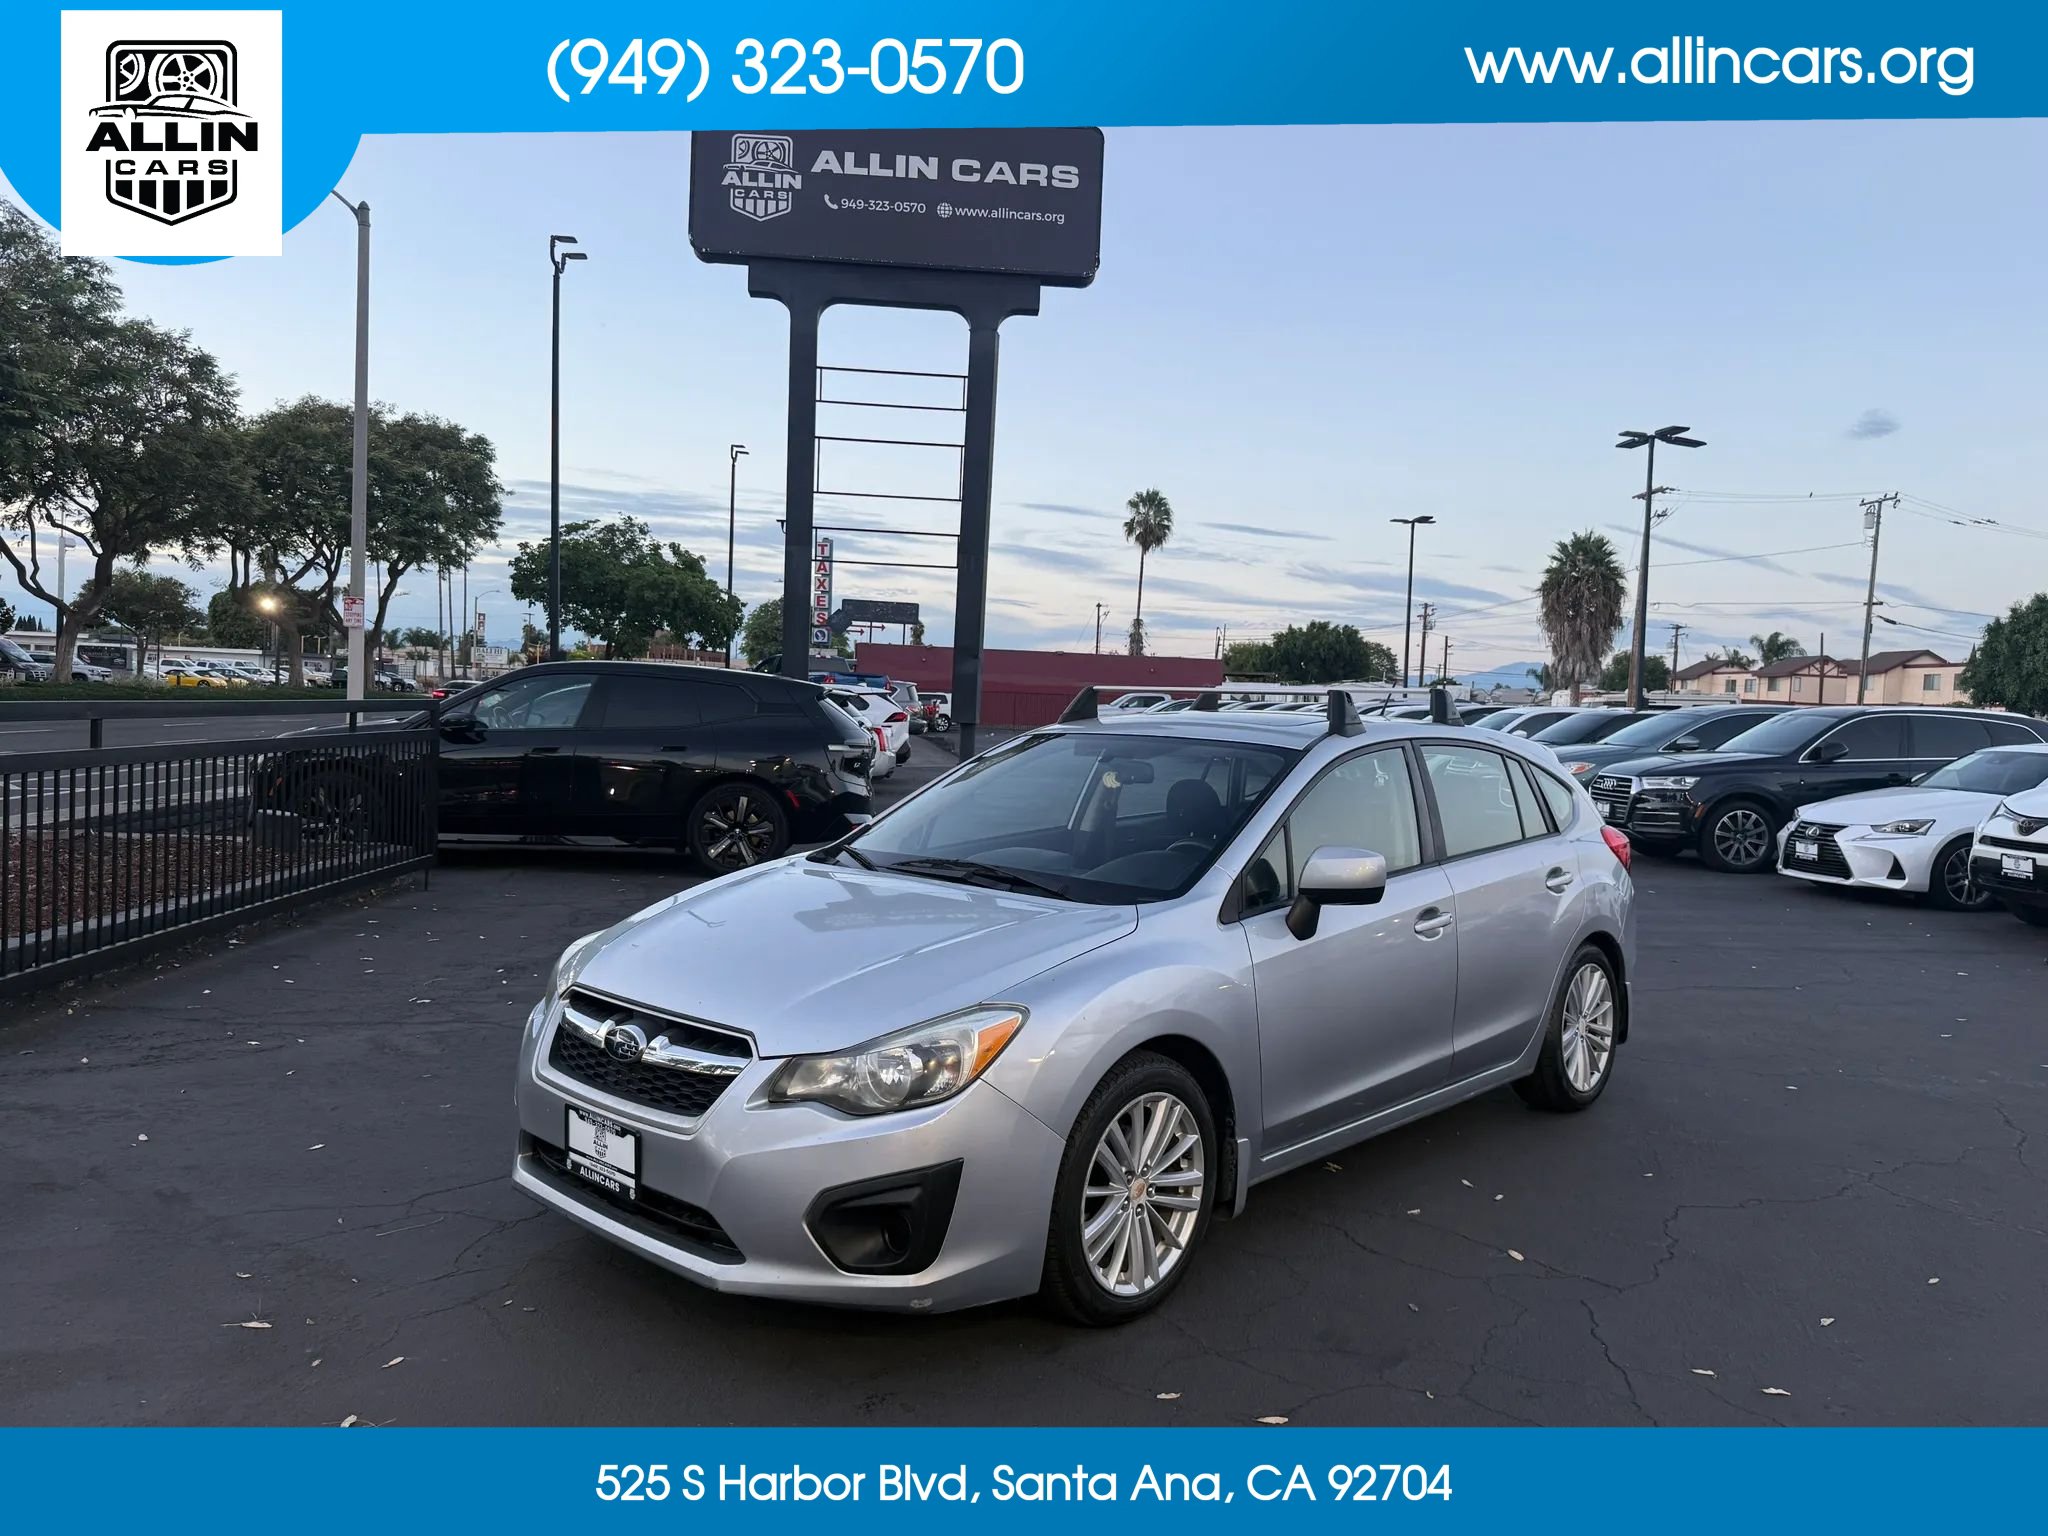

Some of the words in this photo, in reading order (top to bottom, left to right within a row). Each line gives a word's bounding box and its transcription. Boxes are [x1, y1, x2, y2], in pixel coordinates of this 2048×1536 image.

[811, 150, 939, 180] ALLIN
[951, 158, 1080, 189] CARS
[721, 170, 802, 190] ALLIN
[734, 188, 788, 200] CARS
[840, 198, 927, 215] 949-323-0570
[955, 207, 1066, 225] www.allincars.org
[816, 543, 828, 624] TAXES
[580, 1165, 620, 1192] ALLINCARS
